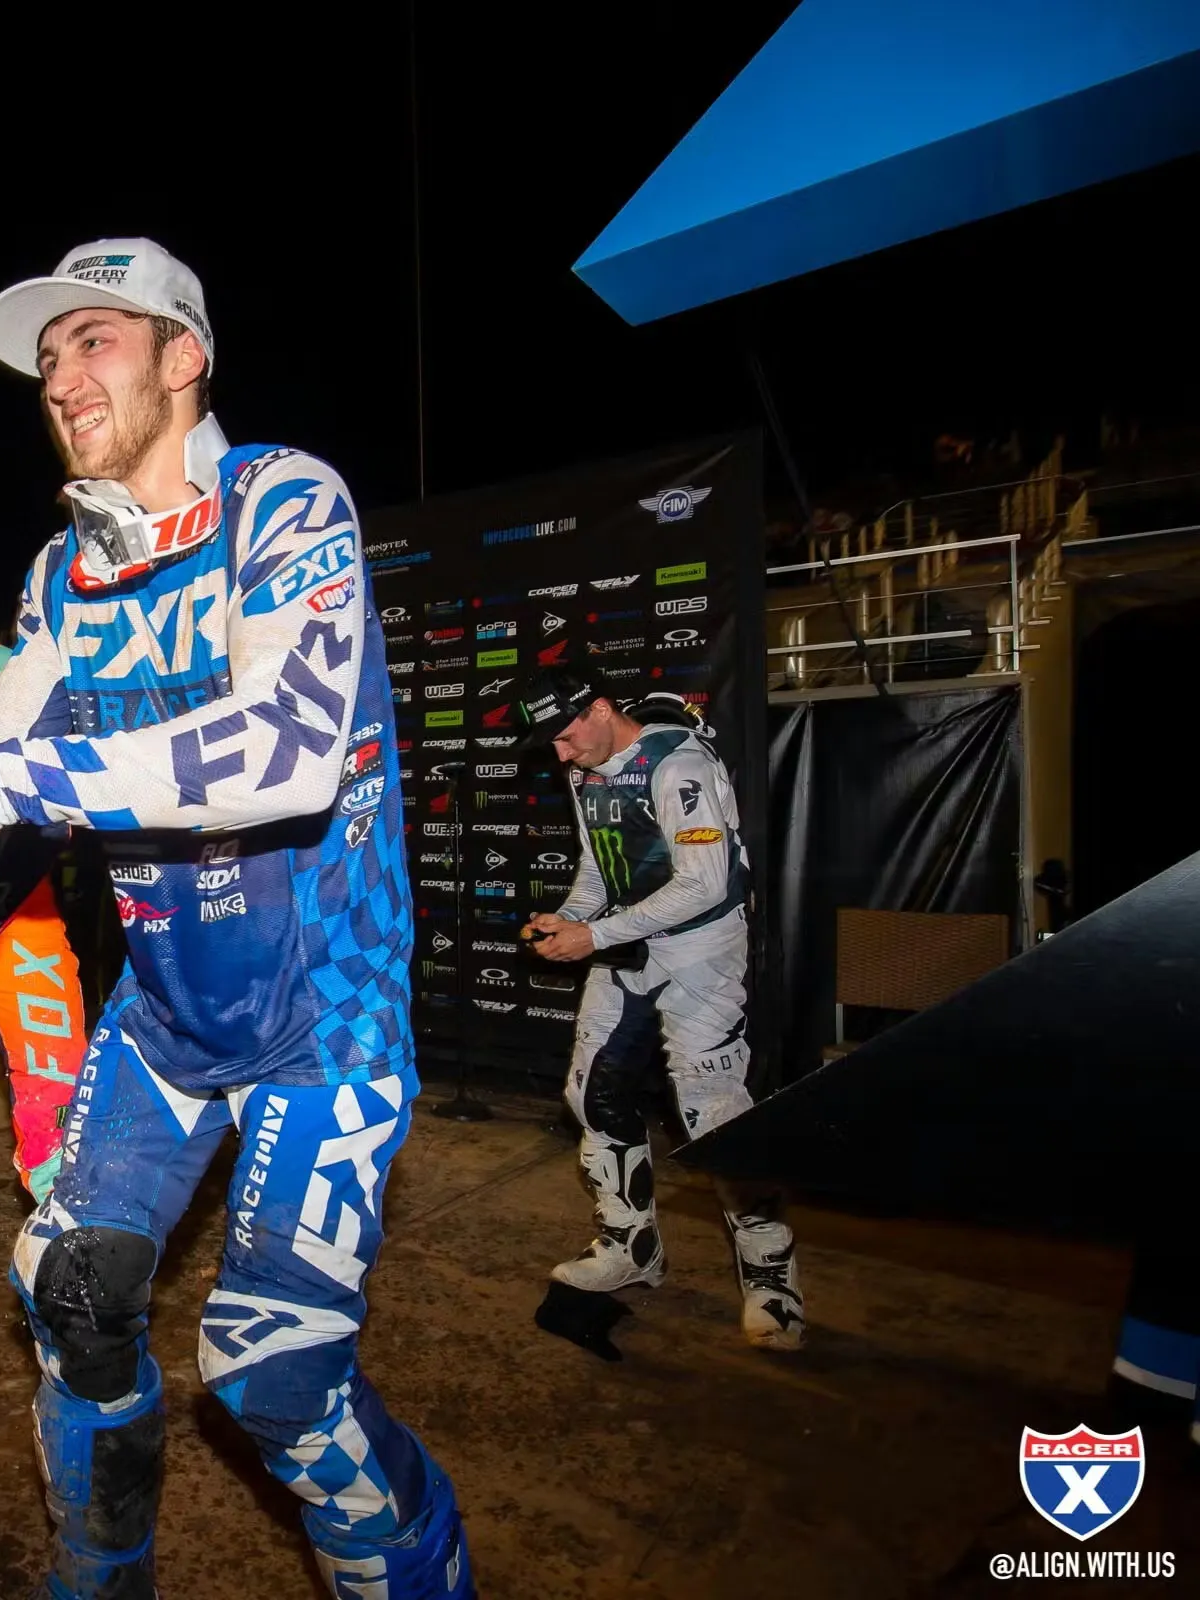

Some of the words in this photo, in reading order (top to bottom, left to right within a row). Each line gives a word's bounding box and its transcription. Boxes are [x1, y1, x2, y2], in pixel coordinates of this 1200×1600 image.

[663, 498, 687, 514] FIM
[660, 568, 702, 580] Kawasaki
[528, 583, 578, 597] COOPER
[655, 596, 707, 616] WPS
[56, 566, 228, 680] FXR
[476, 620, 517, 632] GoPro
[480, 654, 515, 664] Kawasaki
[424, 683, 464, 699] WPS
[422, 739, 467, 749] COOPER
[475, 764, 519, 779] WPS
[613, 773, 647, 786] YAMAHA
[472, 825, 520, 833] COOPER
[676, 829, 722, 846] FMF
[112, 864, 153, 880] SHOEI
[475, 880, 515, 889] GoPro
[201, 892, 247, 922] Mika
[144, 917, 172, 933] MX
[11, 940, 76, 1086] FOX
